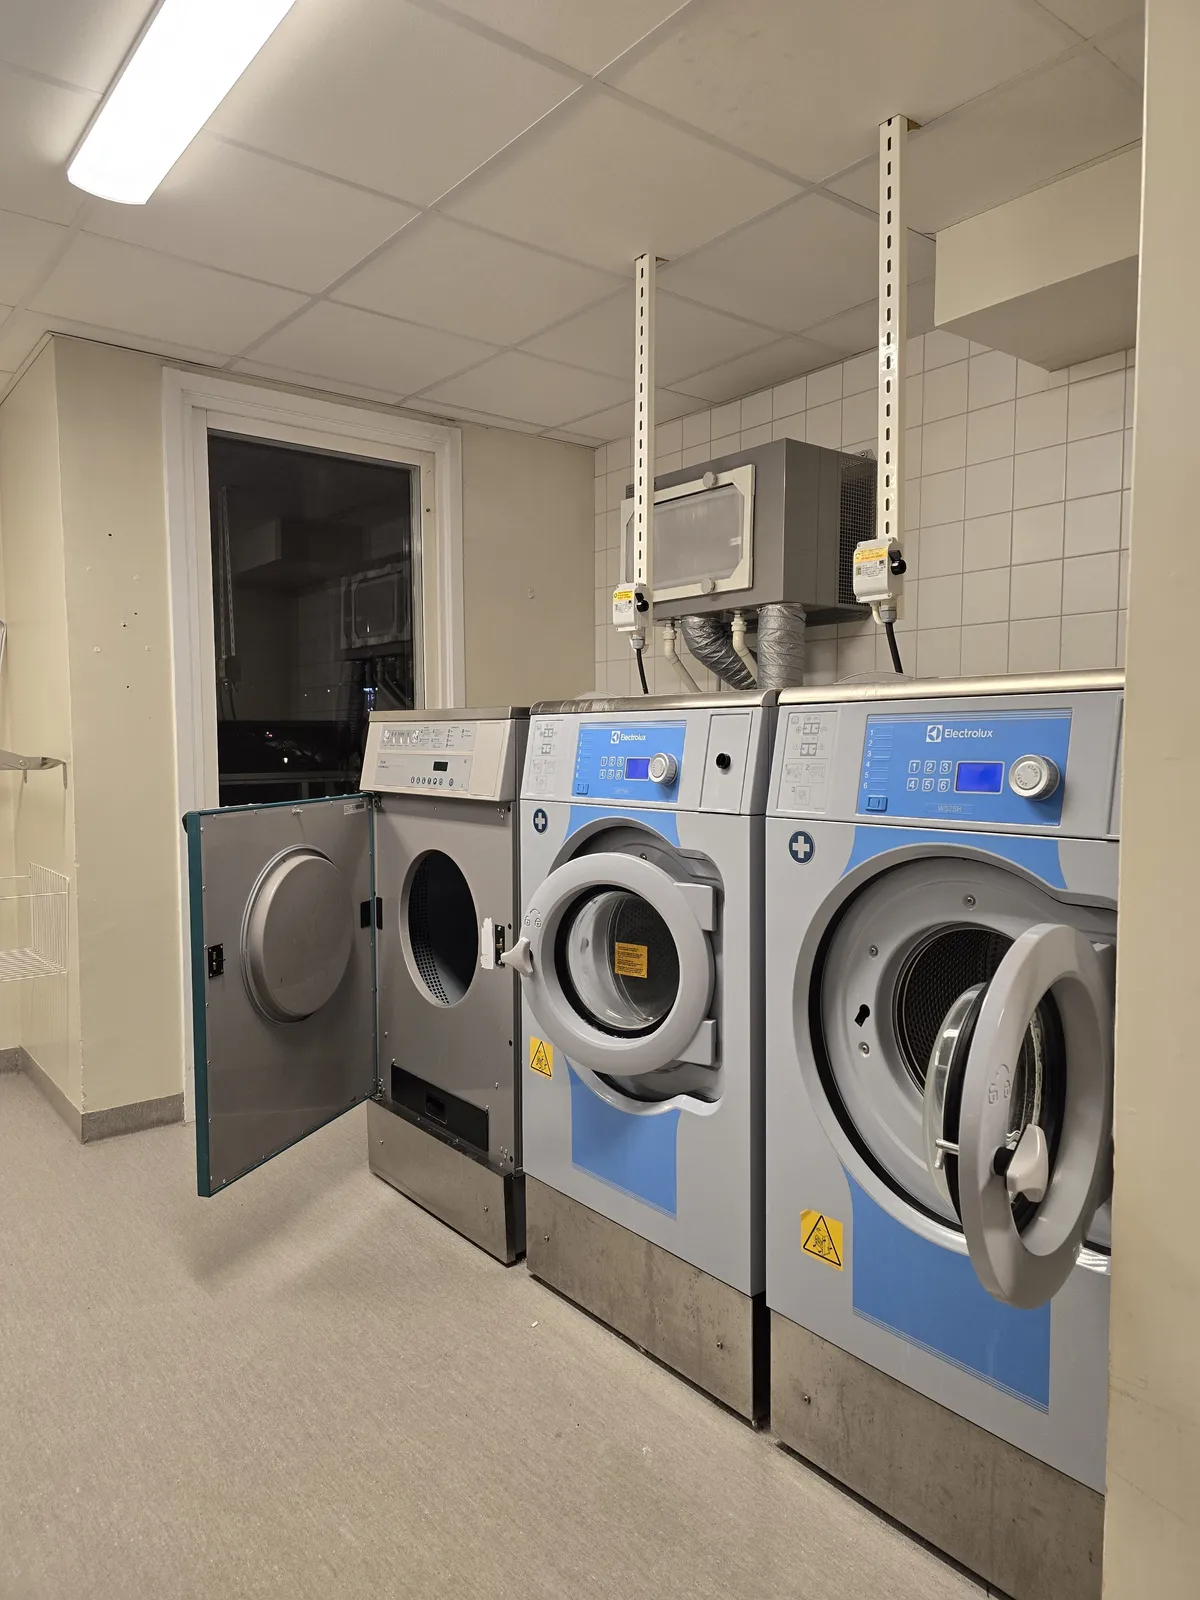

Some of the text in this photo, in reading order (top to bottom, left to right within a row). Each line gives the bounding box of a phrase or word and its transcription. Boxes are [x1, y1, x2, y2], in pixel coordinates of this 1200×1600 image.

[944, 728, 994, 738] Electrolux
[912, 763, 949, 772] 1 2 3
[924, 781, 931, 789] 5
[940, 781, 946, 790] 6
